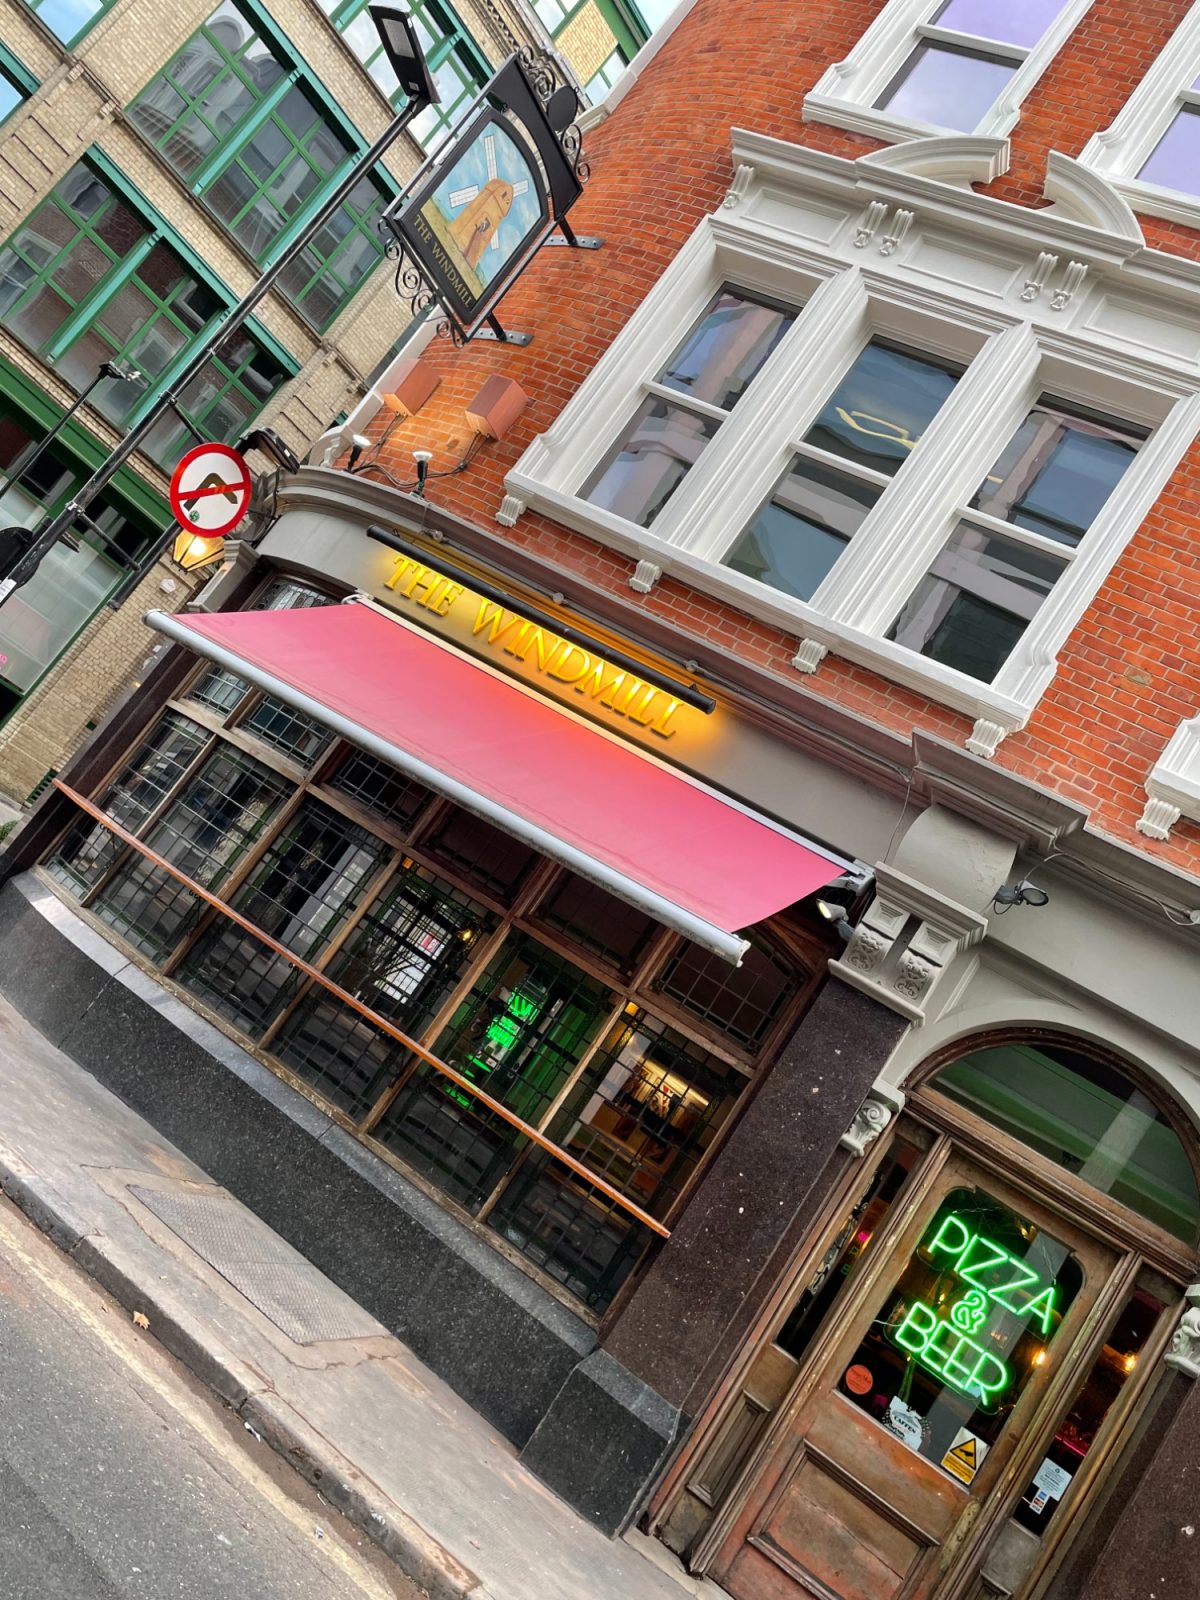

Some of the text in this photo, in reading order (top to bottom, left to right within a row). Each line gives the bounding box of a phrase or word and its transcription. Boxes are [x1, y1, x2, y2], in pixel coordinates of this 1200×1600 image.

[413, 215, 472, 307] THE WINDMILL
[383, 556, 685, 739] THE WINDMILL
[927, 1215, 1055, 1334] PIZZA
[950, 1289, 987, 1334] &
[895, 1301, 1007, 1406] BEER
